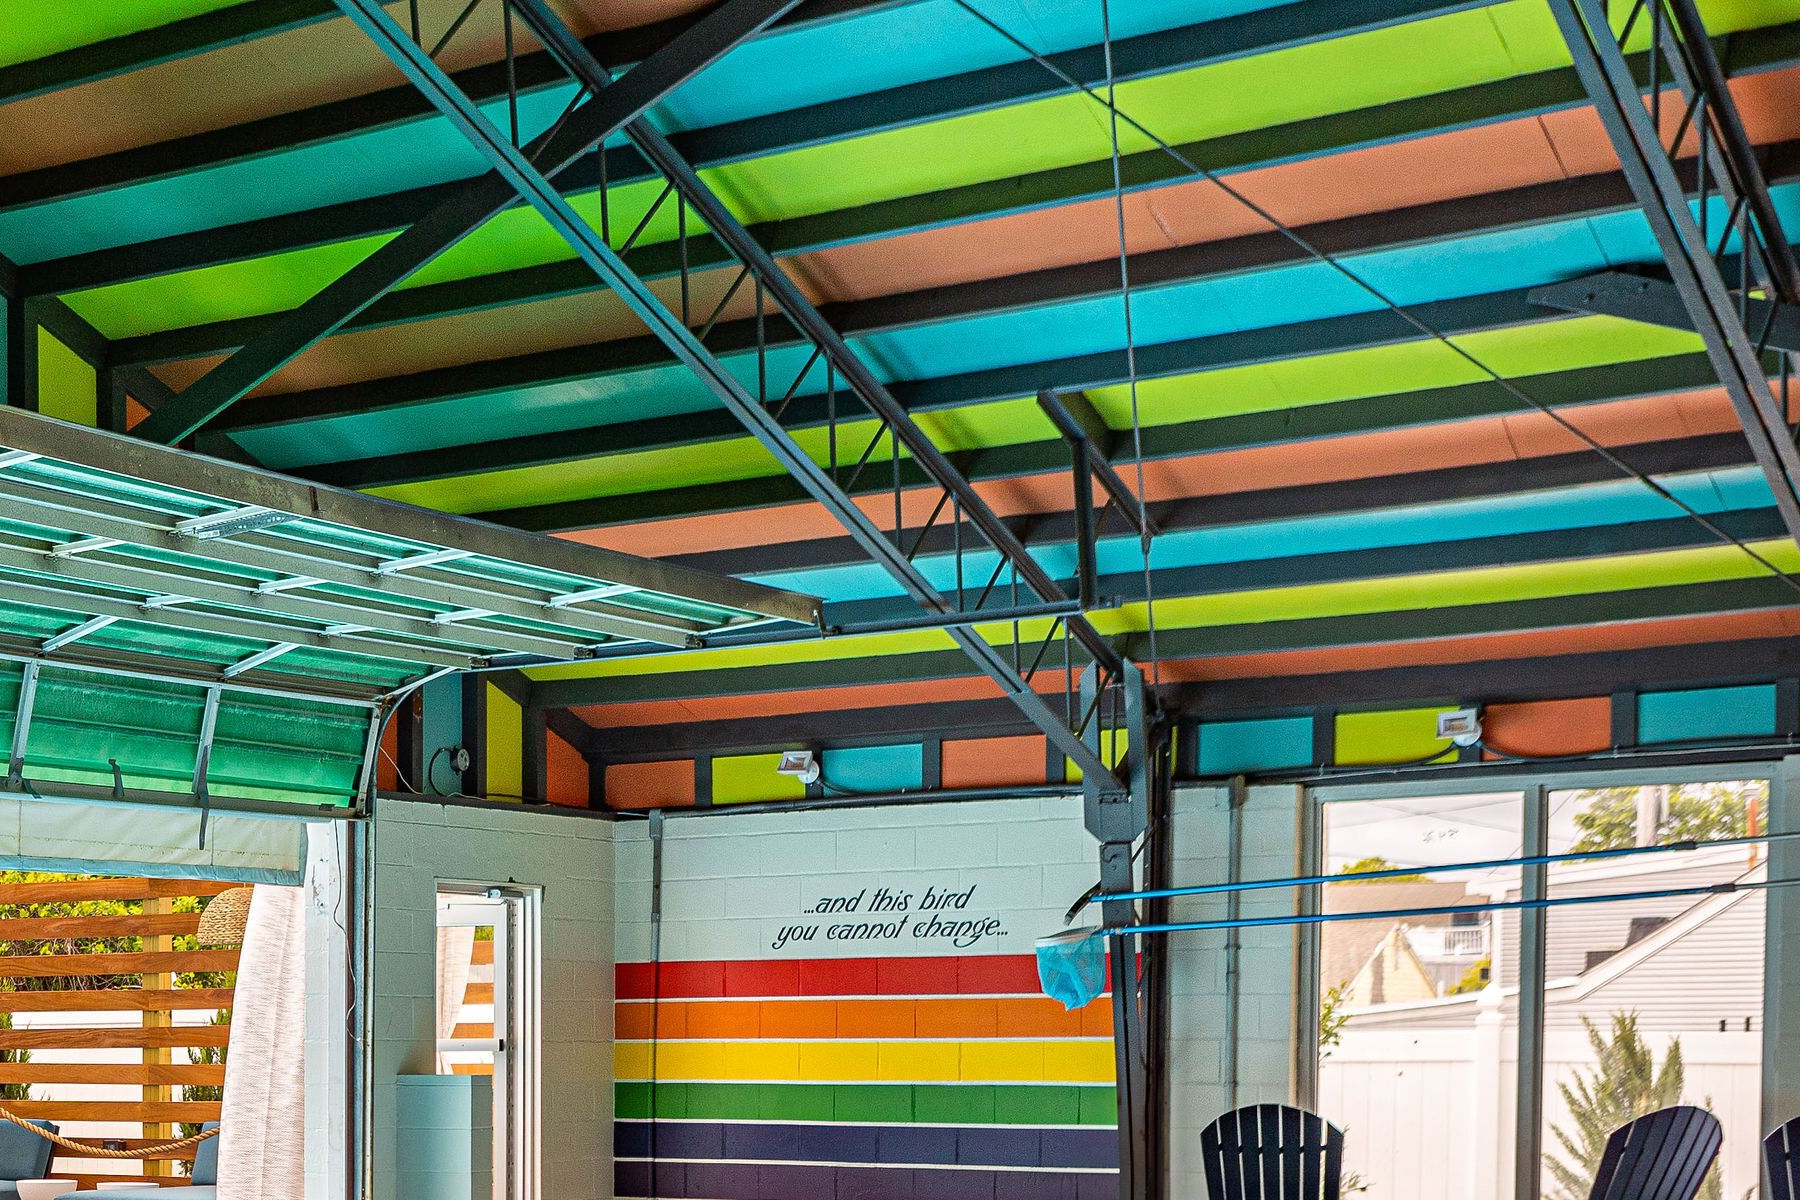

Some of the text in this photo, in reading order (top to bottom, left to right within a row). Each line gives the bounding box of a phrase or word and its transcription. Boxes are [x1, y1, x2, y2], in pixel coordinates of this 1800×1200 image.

[803, 883, 978, 914] ...and this bird
[771, 913, 1009, 950] you cannot change...
